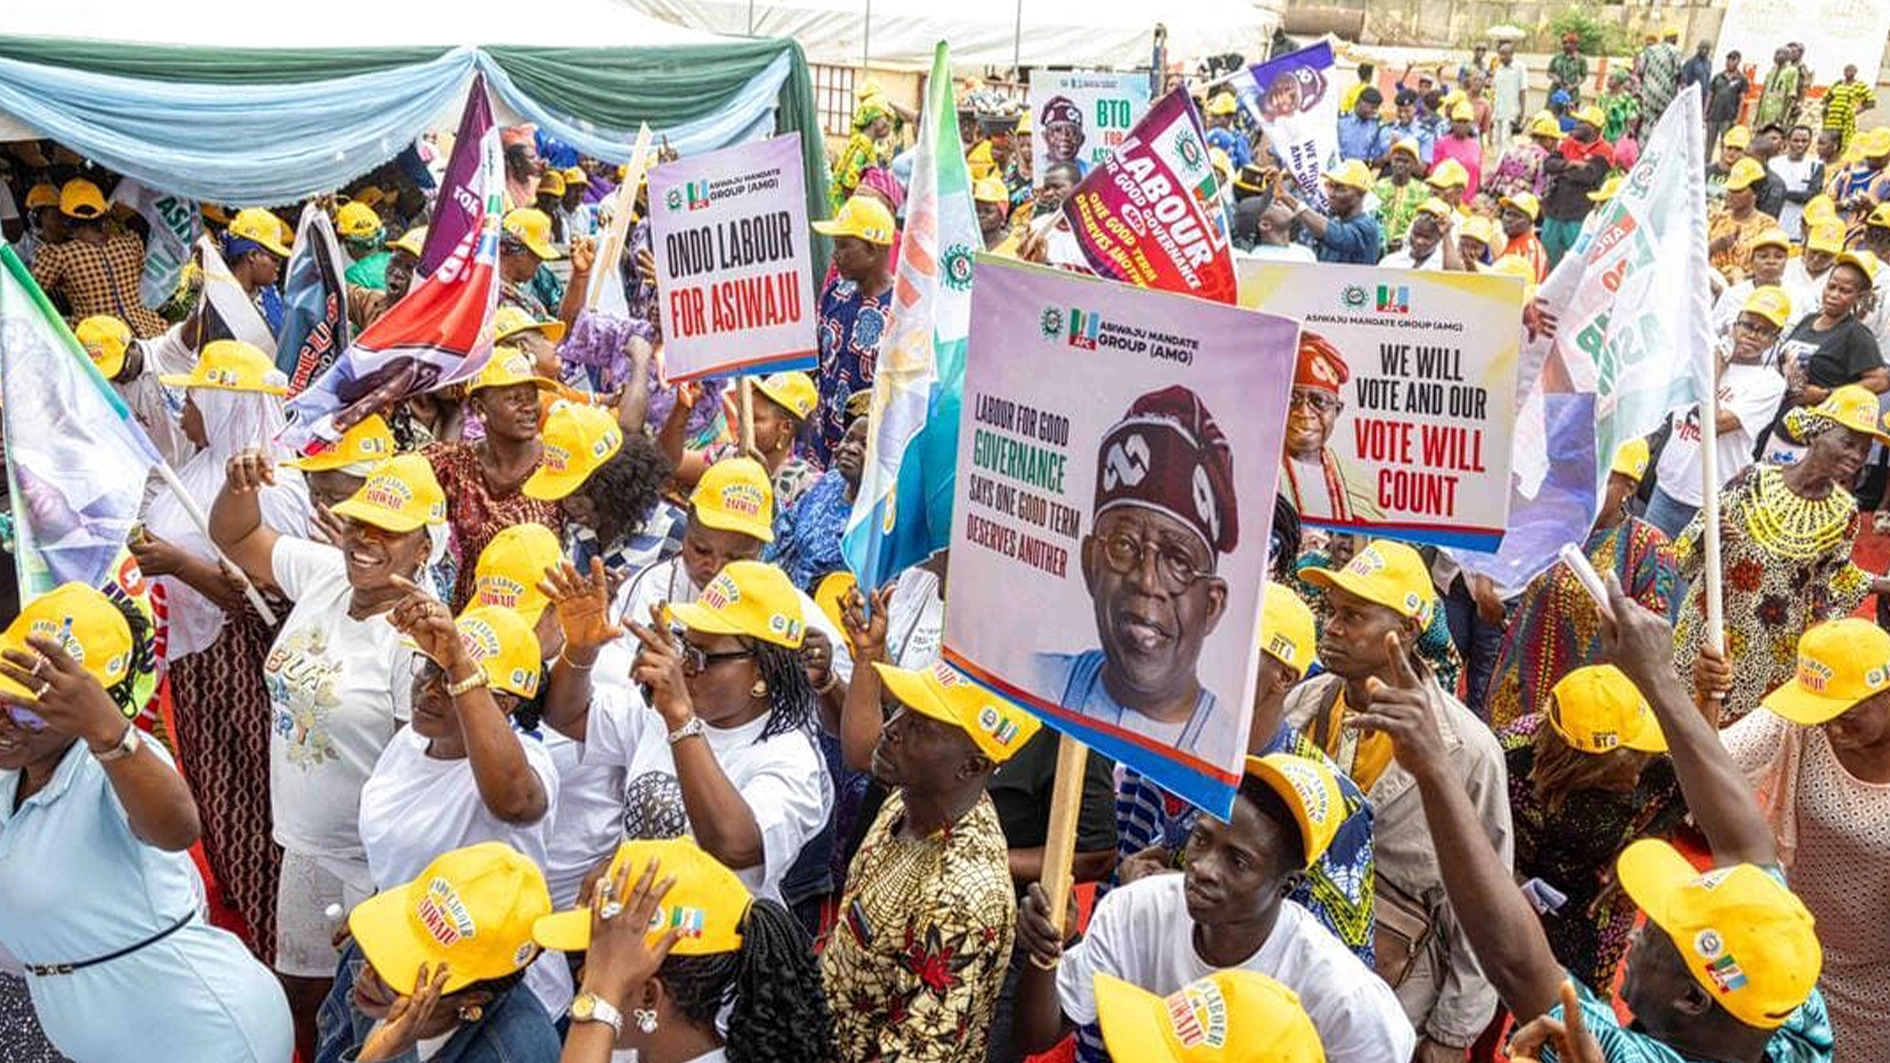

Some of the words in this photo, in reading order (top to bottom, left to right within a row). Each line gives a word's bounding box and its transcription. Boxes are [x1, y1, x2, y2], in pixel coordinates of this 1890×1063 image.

[1097, 99, 1130, 128] BTO
[709, 185, 745, 200] GROUP
[748, 178, 779, 195] (AMG)
[1114, 135, 1213, 269] LABOUR
[666, 225, 714, 278] ONDO
[717, 211, 794, 270] LABOUR
[1075, 193, 1114, 250] DESERVES
[1089, 192, 1110, 219] ONE
[1105, 216, 1136, 246] GOOD
[1131, 246, 1158, 282] TERM
[1114, 173, 1147, 207] GOOD
[1142, 207, 1203, 289] GOVERNANCE
[670, 287, 706, 338] FOR
[711, 270, 801, 333] ASIWAJU
[1305, 313, 1348, 325] ASIWAJU
[1349, 316, 1396, 328] MANDATE
[1397, 319, 1431, 330] GROUP
[1432, 322, 1463, 333] (AMG)
[1098, 334, 1147, 354] GROUP
[1150, 344, 1193, 366] (AMG)
[1100, 321, 1147, 338] ASIWAJU
[1148, 331, 1199, 349] MANDATE
[1380, 343, 1410, 377] WE
[1416, 346, 1464, 381] WILL
[975, 392, 1014, 431] LABOUR
[1016, 405, 1037, 438] FOR
[1039, 411, 1070, 447] GOOD
[1356, 377, 1400, 412] VOTE
[1405, 381, 1443, 416] AND
[1449, 385, 1487, 421] OUR
[973, 428, 1068, 495] GOVERNANCE
[1354, 417, 1414, 464] VOTE
[1421, 424, 1485, 473] WILL
[969, 473, 994, 509] SAYS
[995, 483, 1015, 517] ONE
[1017, 490, 1047, 527] GOOD
[1049, 502, 1081, 540] TERM
[1378, 468, 1459, 517] COUNT
[966, 513, 1016, 558] DESERVES
[1017, 533, 1068, 579] ANOTHER
